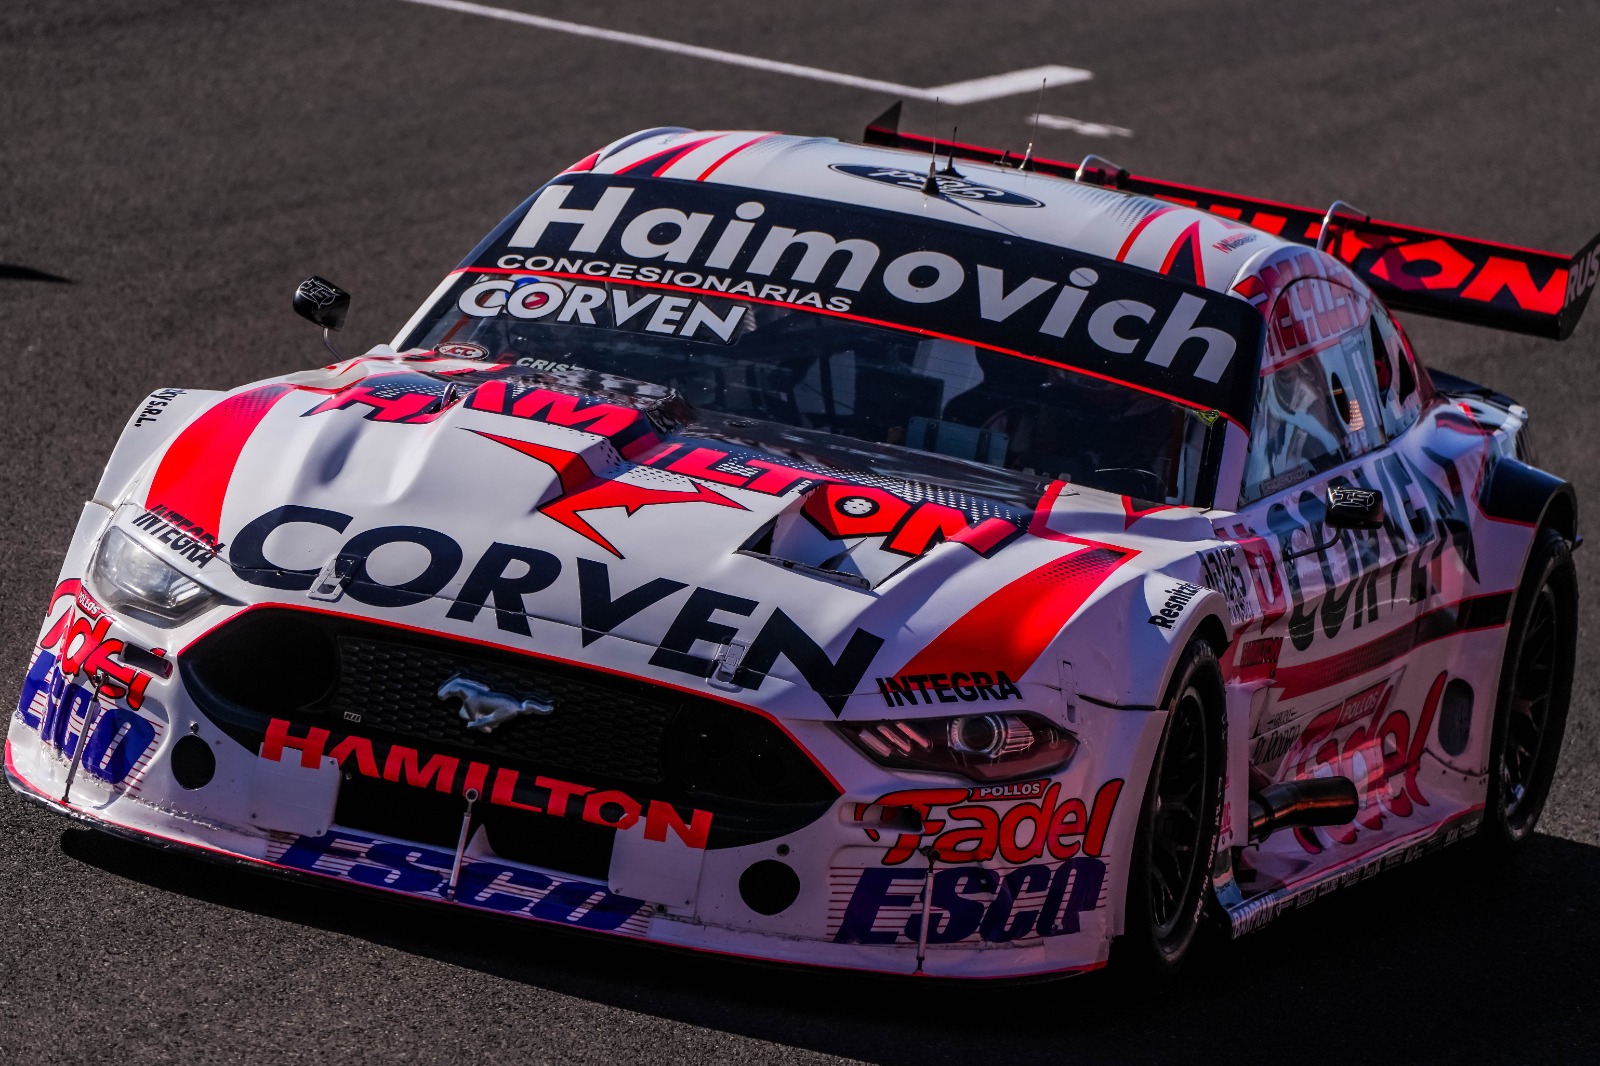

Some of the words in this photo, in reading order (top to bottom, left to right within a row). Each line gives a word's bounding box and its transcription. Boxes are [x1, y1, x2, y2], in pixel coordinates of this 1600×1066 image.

[457, 279, 748, 344] CORVEN
[497, 254, 853, 313] CONCESIONARIAS
[507, 184, 1237, 384] Haimovich
[301, 378, 1029, 558] HAMILTON
[132, 503, 226, 570] INTEGRA
[1266, 451, 1480, 651] CORVEN
[229, 504, 884, 718] CORVEN
[875, 670, 1024, 708] INTEGRA
[260, 717, 714, 849] HAMILTON
[854, 777, 1125, 865] Fadel
[979, 783, 1041, 797] POLLOS
[276, 830, 648, 931] ESCO
[833, 856, 1107, 944] ESCO
